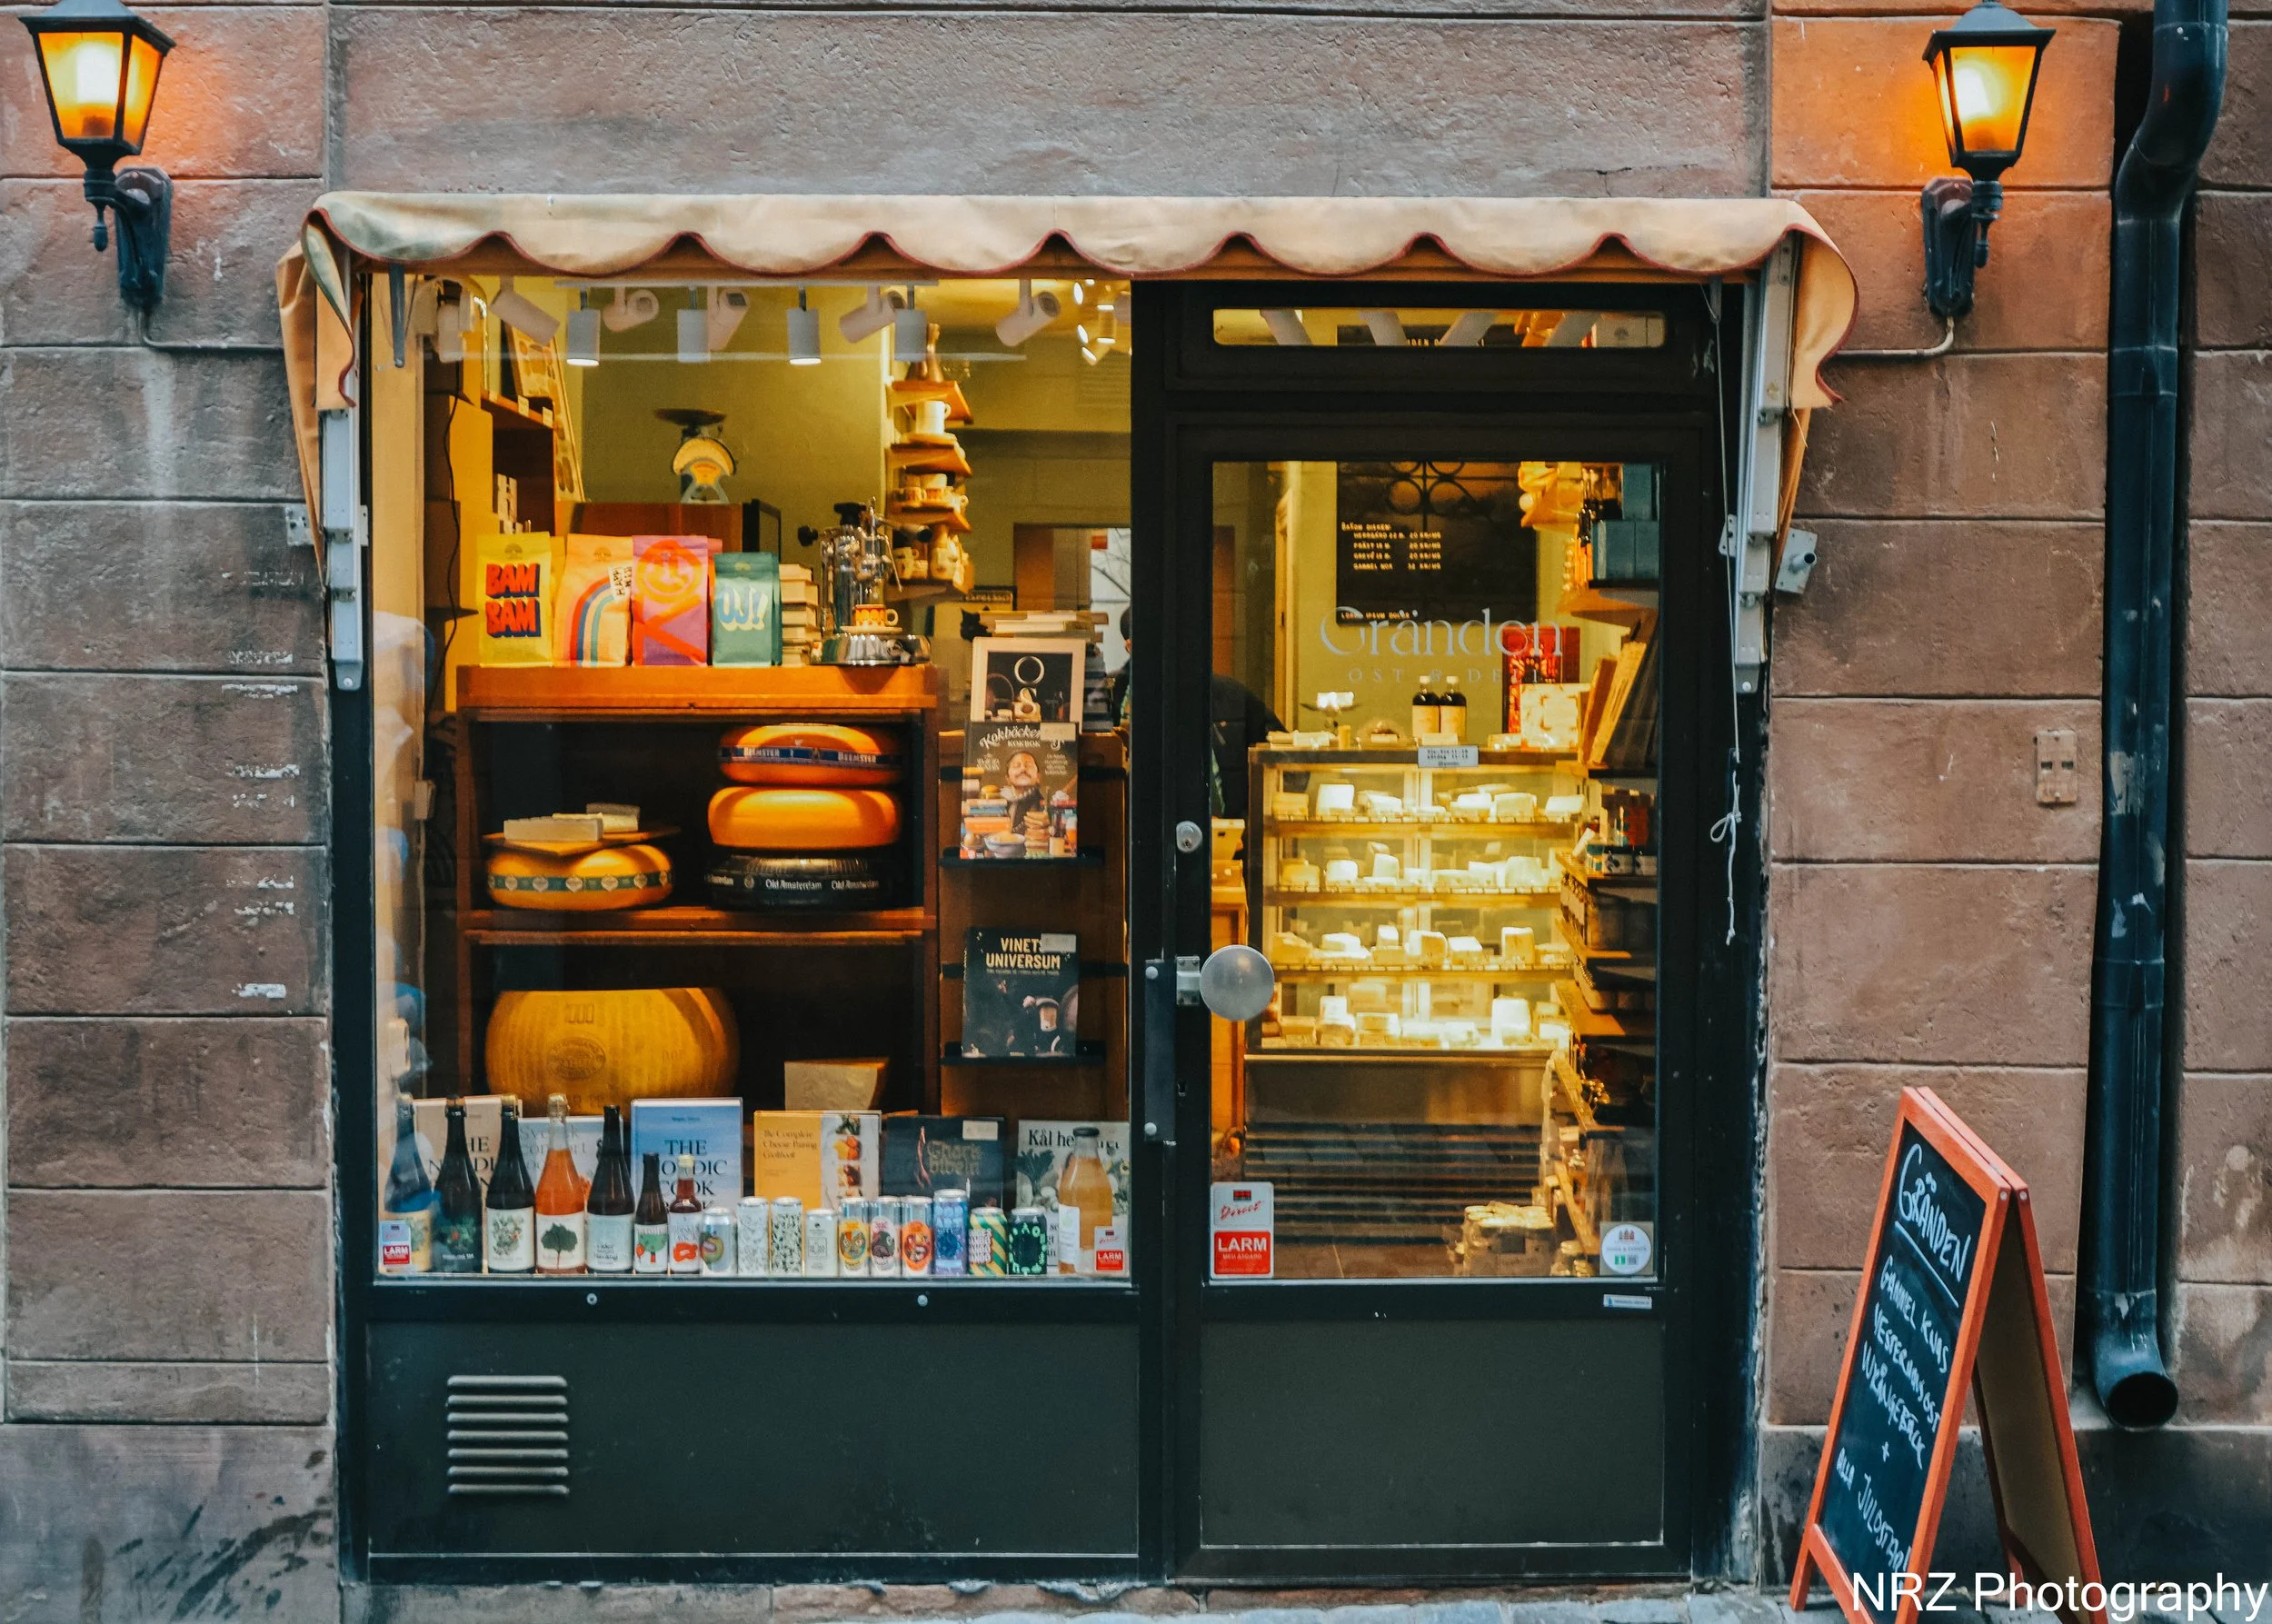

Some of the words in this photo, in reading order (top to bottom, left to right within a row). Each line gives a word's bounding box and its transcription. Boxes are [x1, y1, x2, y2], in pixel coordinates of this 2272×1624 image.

[485, 563, 539, 599] BAM
[484, 597, 541, 637] BAM
[1348, 667, 1405, 682] OST
[765, 878, 779, 889] Old
[779, 879, 822, 892] Amsterdam
[985, 952, 1061, 970] UNIVERSUM
[1028, 1129, 1053, 1147] Kål
[663, 1139, 708, 1156] THE
[661, 1159, 728, 1177] ODIC
[1898, 1142, 1972, 1283] GRÄNDEN
[384, 1246, 409, 1256] LARM
[1218, 1237, 1268, 1252] LARM
[1097, 1251, 1122, 1260] LARM
